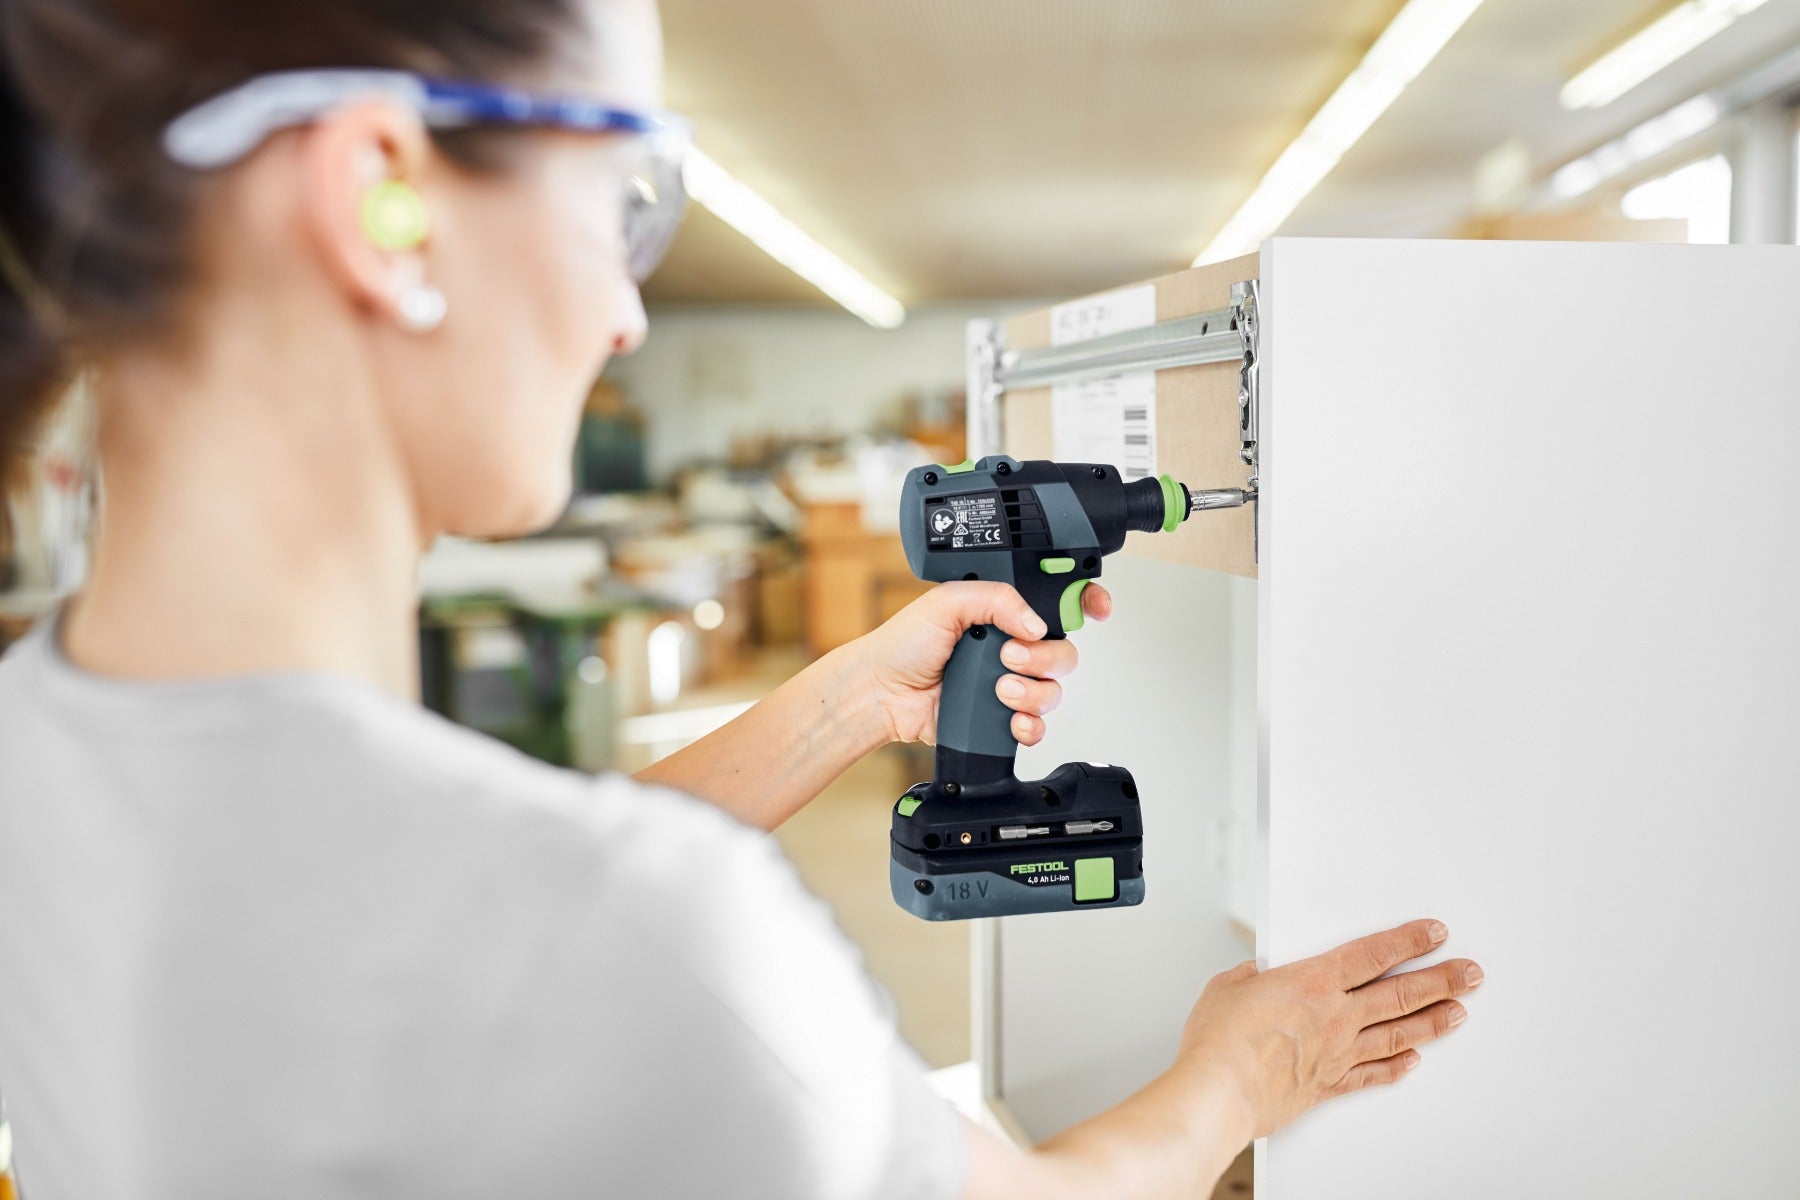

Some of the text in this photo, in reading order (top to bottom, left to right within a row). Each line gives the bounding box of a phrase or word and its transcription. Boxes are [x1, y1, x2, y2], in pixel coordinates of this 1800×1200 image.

[1010, 861, 1069, 874] FESTOOL
[1028, 874, 1070, 884] 4,0 Ah Li-Ion
[948, 880, 989, 900] 18 V
